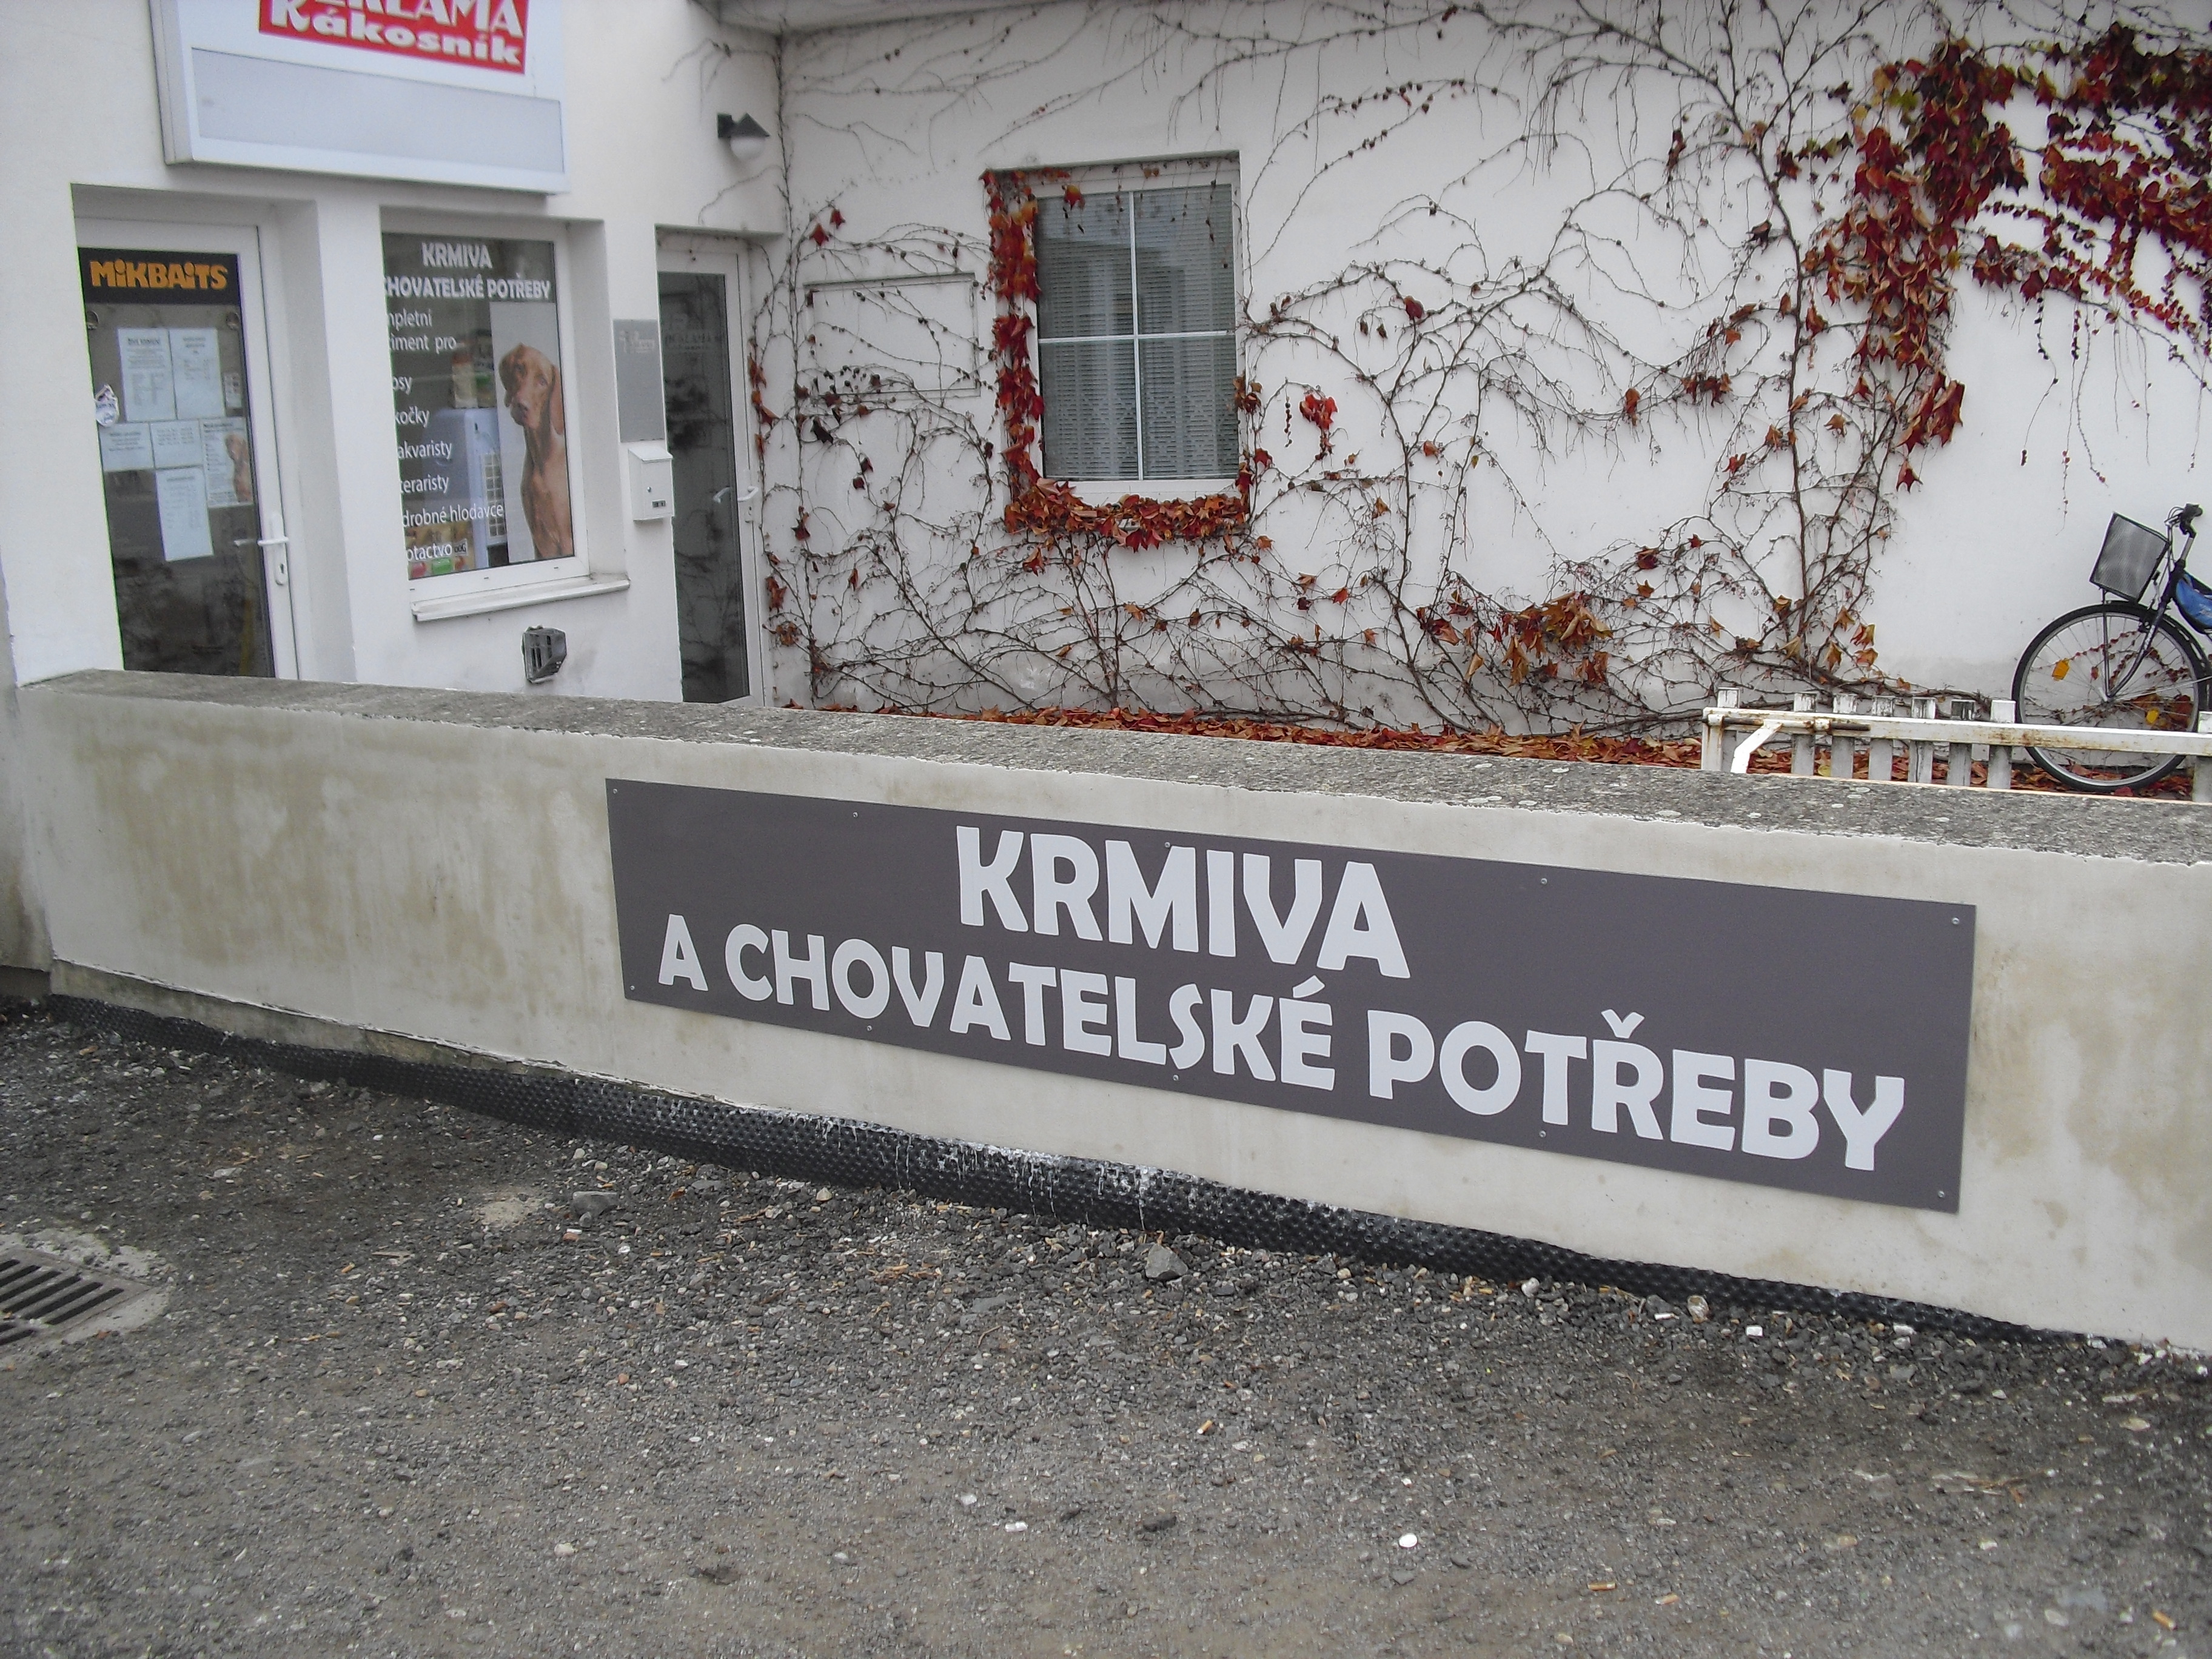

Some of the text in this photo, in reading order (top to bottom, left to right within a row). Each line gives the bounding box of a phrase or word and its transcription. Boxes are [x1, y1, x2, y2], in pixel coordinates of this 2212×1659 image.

[421, 242, 494, 269] KRMIVA
[486, 272, 551, 299] POTŘEBY
[435, 337, 457, 354] pro
[398, 440, 452, 460] akvaristy
[402, 503, 504, 528] drobné hlodavce
[957, 825, 1411, 978] KRMIVA
[659, 914, 1905, 1171] A CHOVATELSKÉ POTŘEBY
